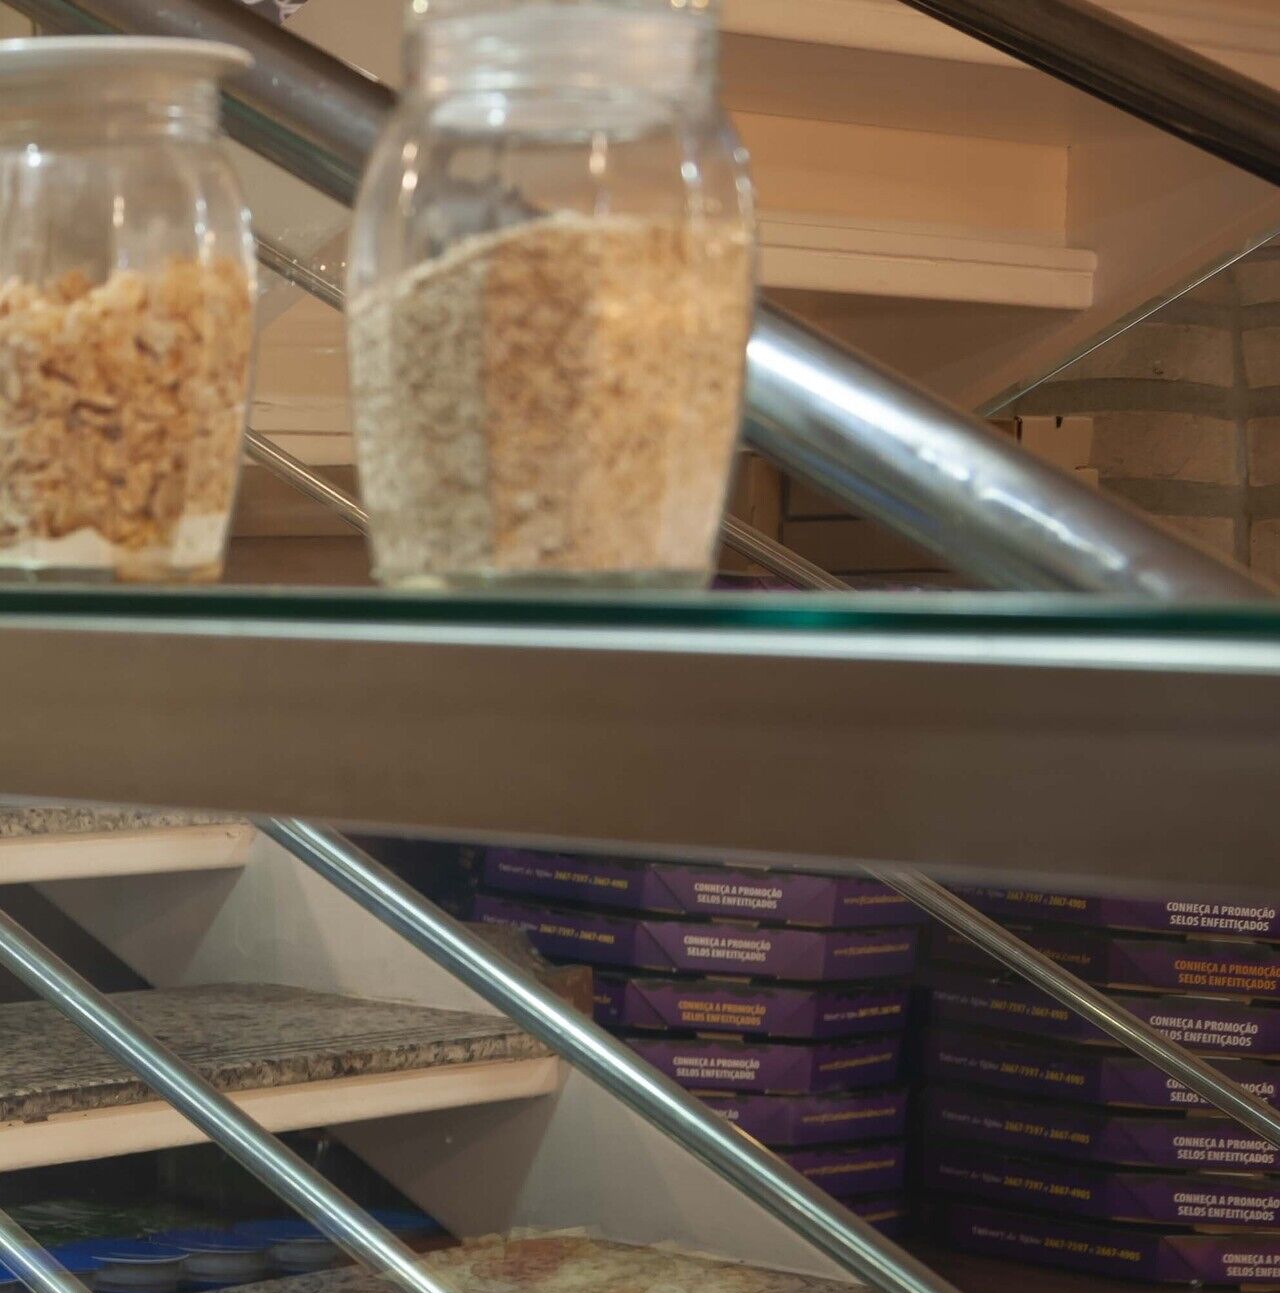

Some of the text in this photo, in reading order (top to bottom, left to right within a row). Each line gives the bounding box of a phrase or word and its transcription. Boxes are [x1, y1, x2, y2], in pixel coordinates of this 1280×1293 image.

[694, 882, 782, 900] CONHEÇA A PROMOÇÃO
[697, 894, 777, 909] SELOS ENFEITIÇADOS
[1167, 902, 1275, 920] CONHEÇA A PROMOÇÃO
[1170, 915, 1269, 931] SELOS ENFEITIÇADOS
[684, 935, 771, 951] CONHEÇA A PROMOÇÃO
[687, 946, 766, 962] SELOS ENFEITIÇADOS
[1175, 960, 1217, 973] CONHEÇA
[1220, 963, 1227, 973] A
[1179, 974, 1276, 990] SELOS ENFEITIÇADOS
[678, 1000, 766, 1017] CONHEÇA A PROMOÇÃO
[681, 1011, 760, 1027] SELOS ENFEITIÇADOS
[1150, 1015, 1258, 1034] CONHEÇA A PROMOÇÃO
[1184, 1032, 1252, 1047] ENFEITIÇADOS
[673, 1057, 760, 1071] CONHEÇA A PROMOÇÃO
[676, 1067, 755, 1081] SELOS ENFEITIÇADOS
[1170, 1091, 1198, 1103] SELOS
[1173, 1136, 1216, 1149] CONHEÇA
[1218, 1139, 1224, 1148] A
[1177, 1149, 1274, 1164] SELOS ENFEITIÇADOS
[1174, 1193, 1280, 1209] CONHEÇA A PROMOÇÃO
[1178, 1206, 1274, 1222] SELOS ENFEITIÇADOS
[1222, 1253, 1264, 1266] CONHEÇA
[1265, 1255, 1272, 1264] A
[1227, 1267, 1254, 1277] SELOS
